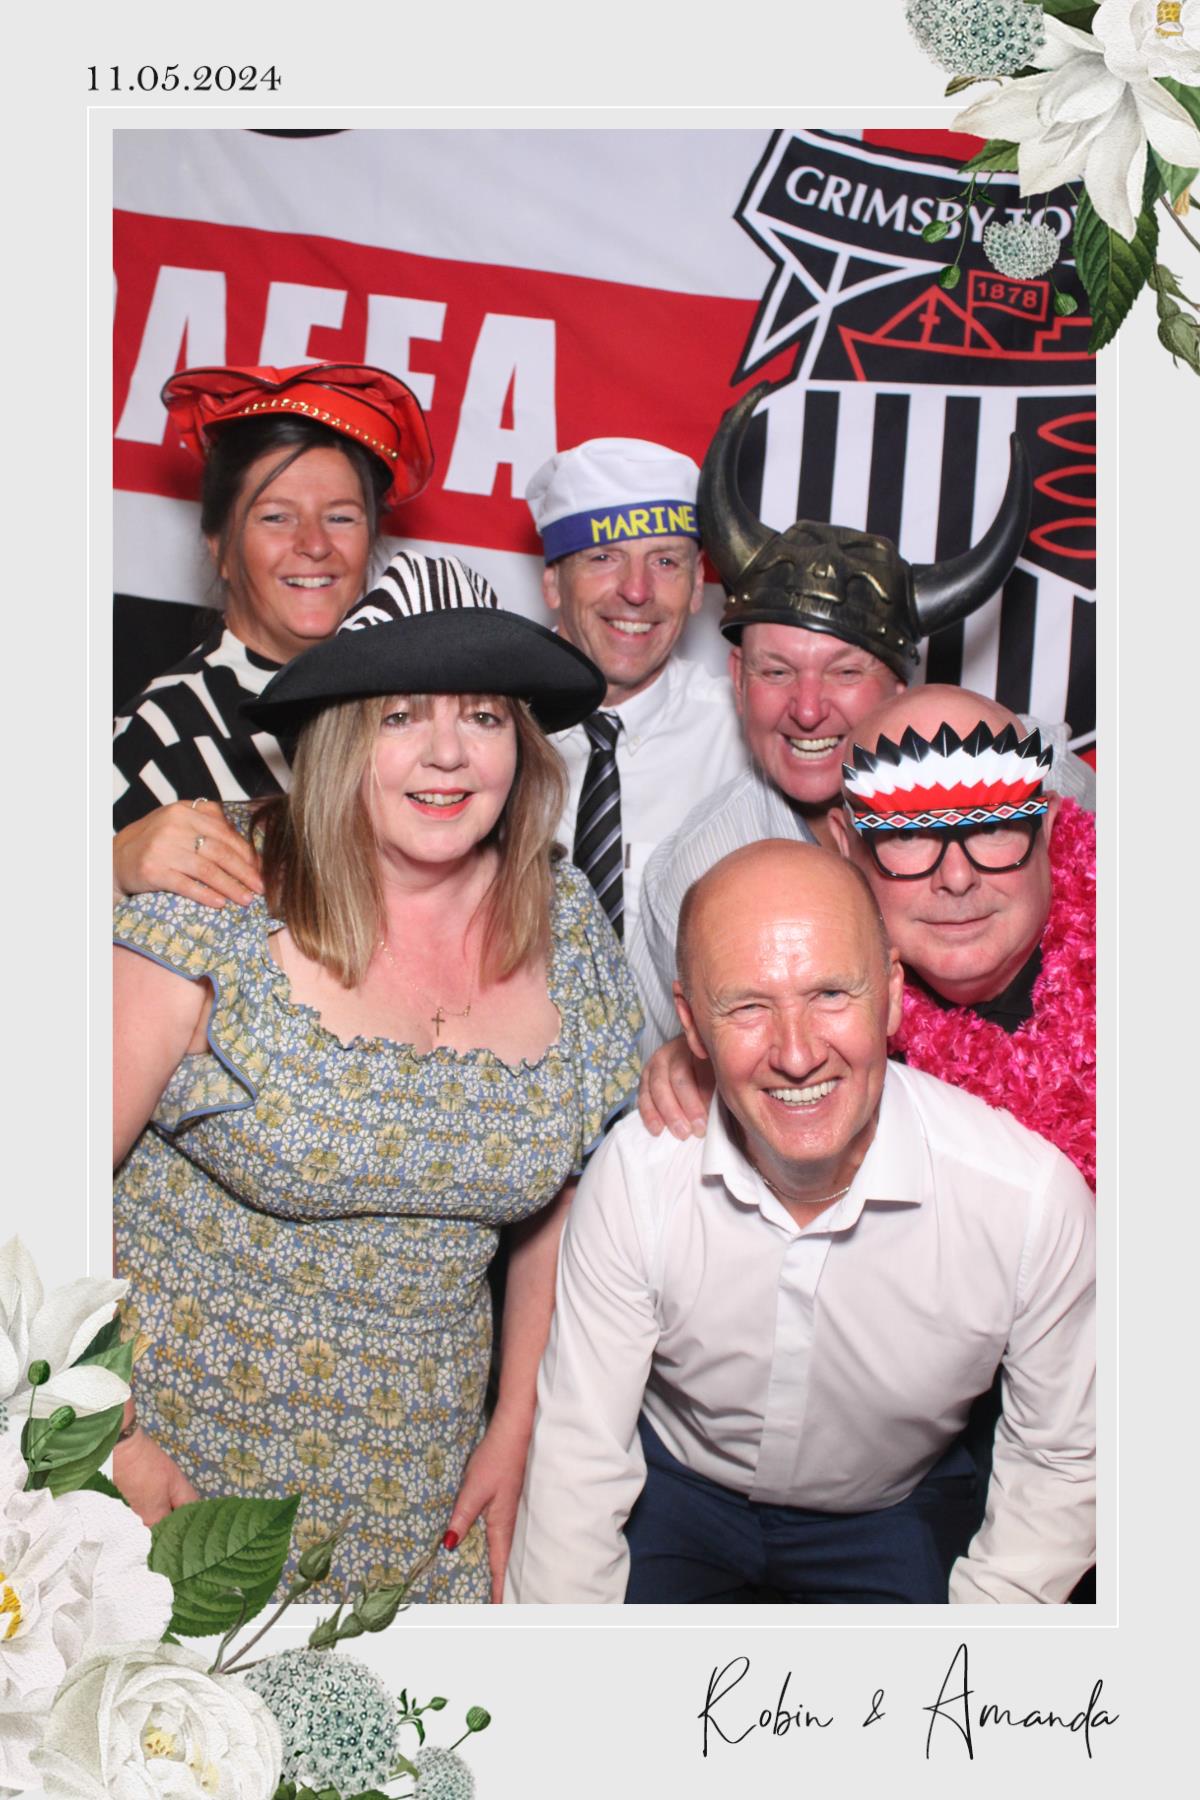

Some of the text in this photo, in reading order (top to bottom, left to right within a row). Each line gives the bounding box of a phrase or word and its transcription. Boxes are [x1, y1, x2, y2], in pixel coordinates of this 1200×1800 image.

[784, 165, 996, 243] GRIMSBY
[977, 281, 1038, 308] 1878
[590, 505, 698, 544] MARINE
